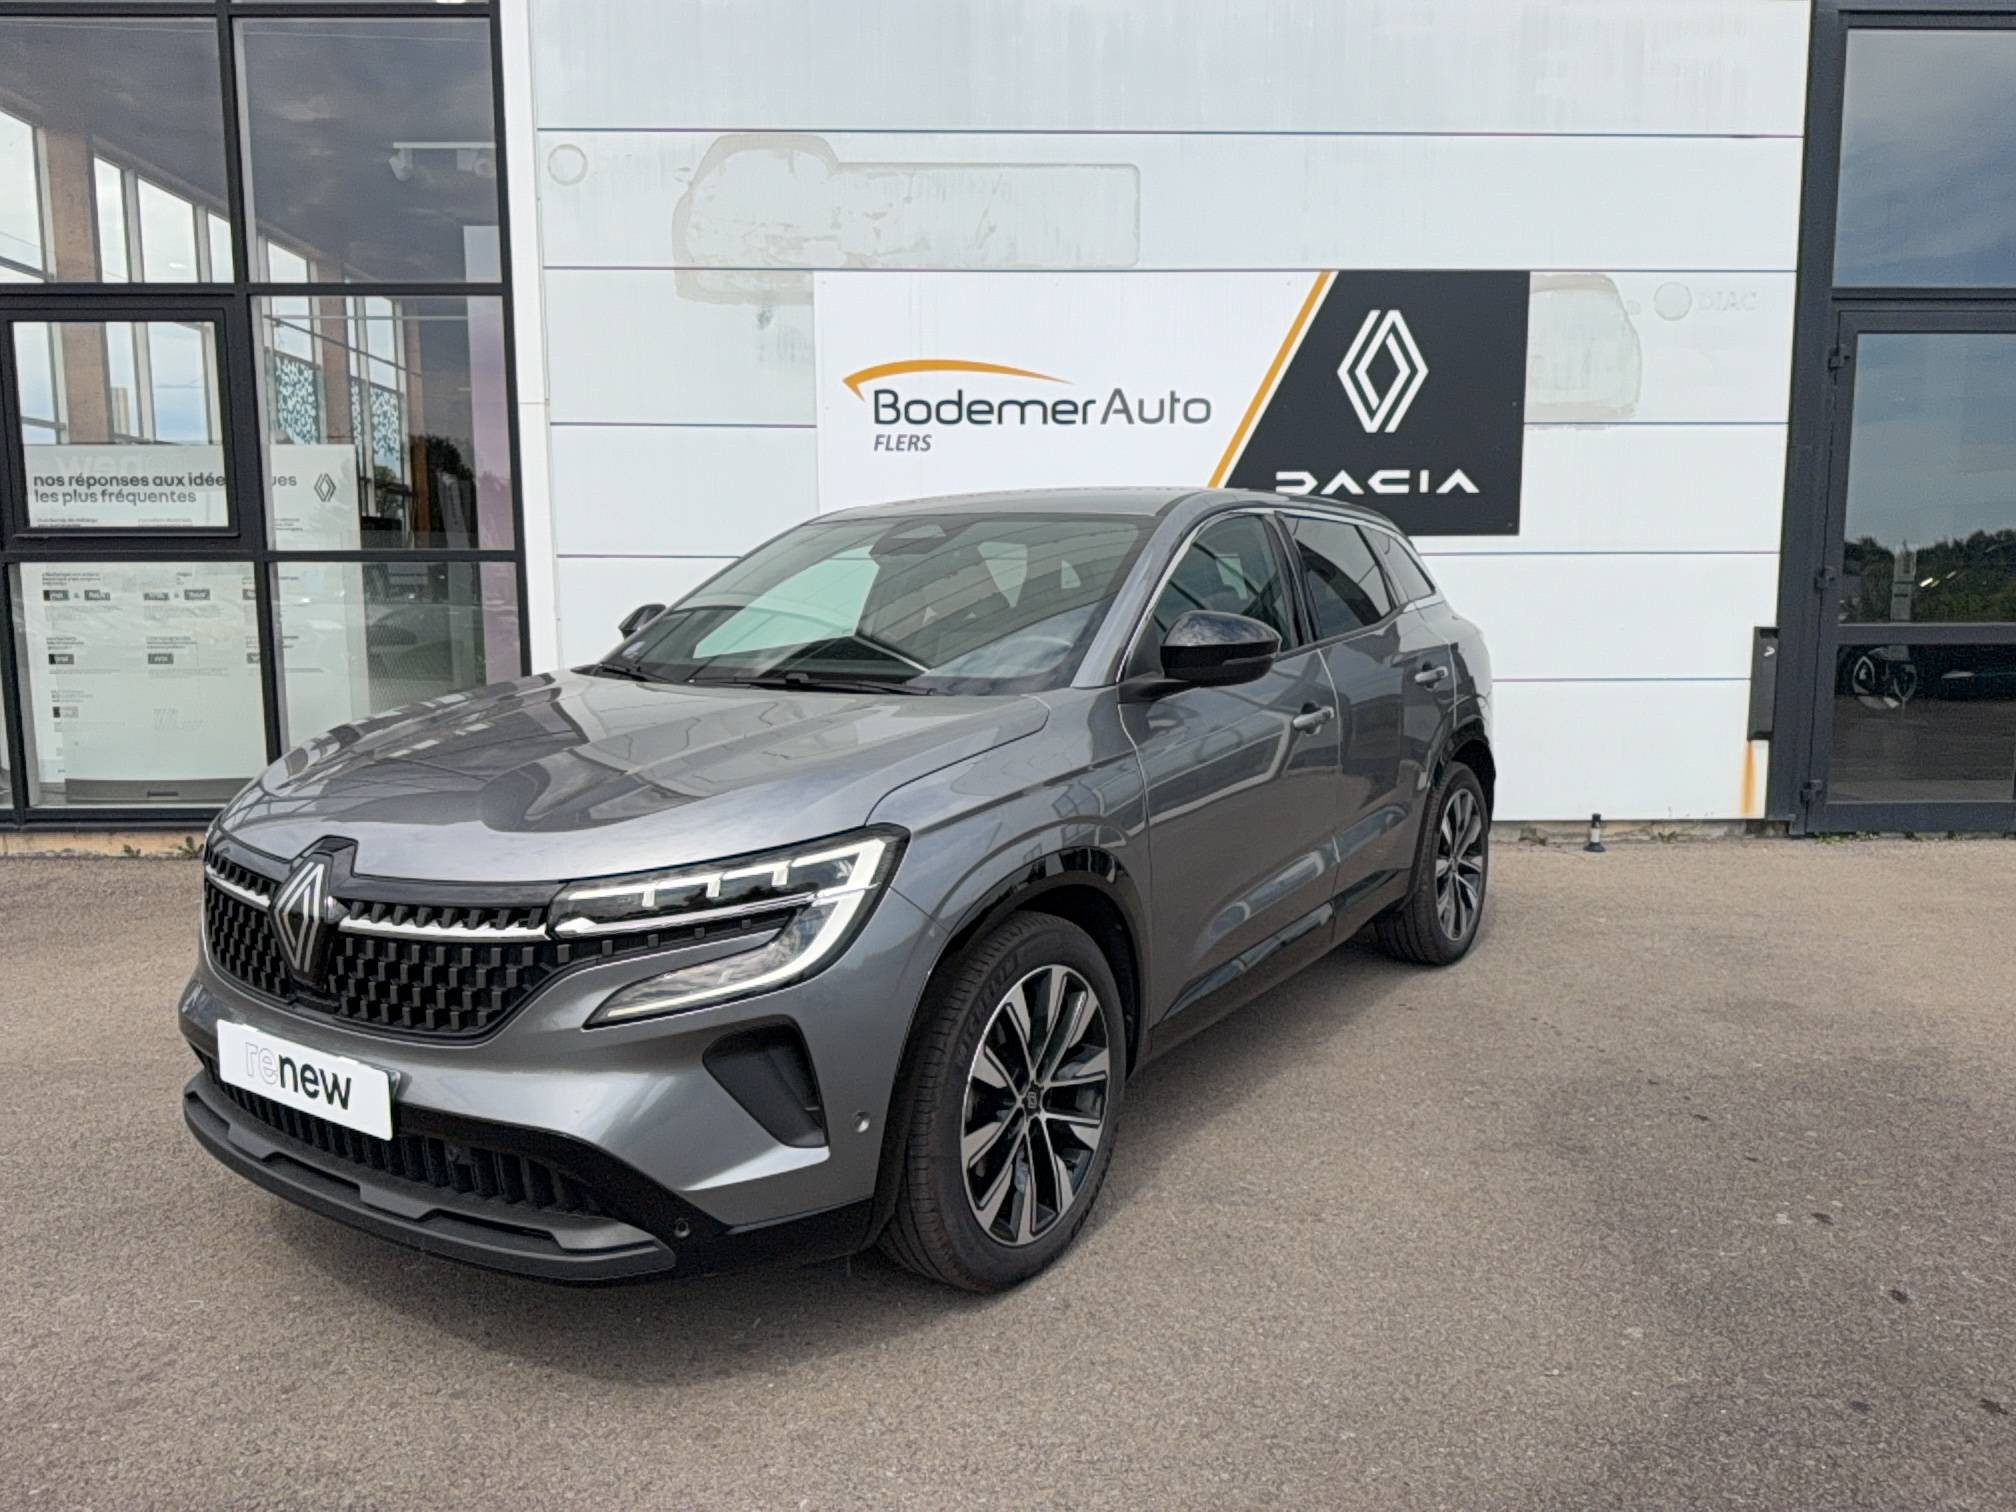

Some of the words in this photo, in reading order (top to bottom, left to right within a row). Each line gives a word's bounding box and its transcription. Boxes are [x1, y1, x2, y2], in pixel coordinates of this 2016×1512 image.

[873, 433, 932, 452] FLERS
[33, 474, 65, 487] nos
[68, 472, 149, 490] réponses
[152, 475, 186, 487] aux
[1275, 469, 1480, 494] DACIA
[34, 490, 58, 503] les
[62, 490, 98, 506] plus
[101, 490, 197, 507] fréquentes
[245, 1042, 352, 1110] renew
